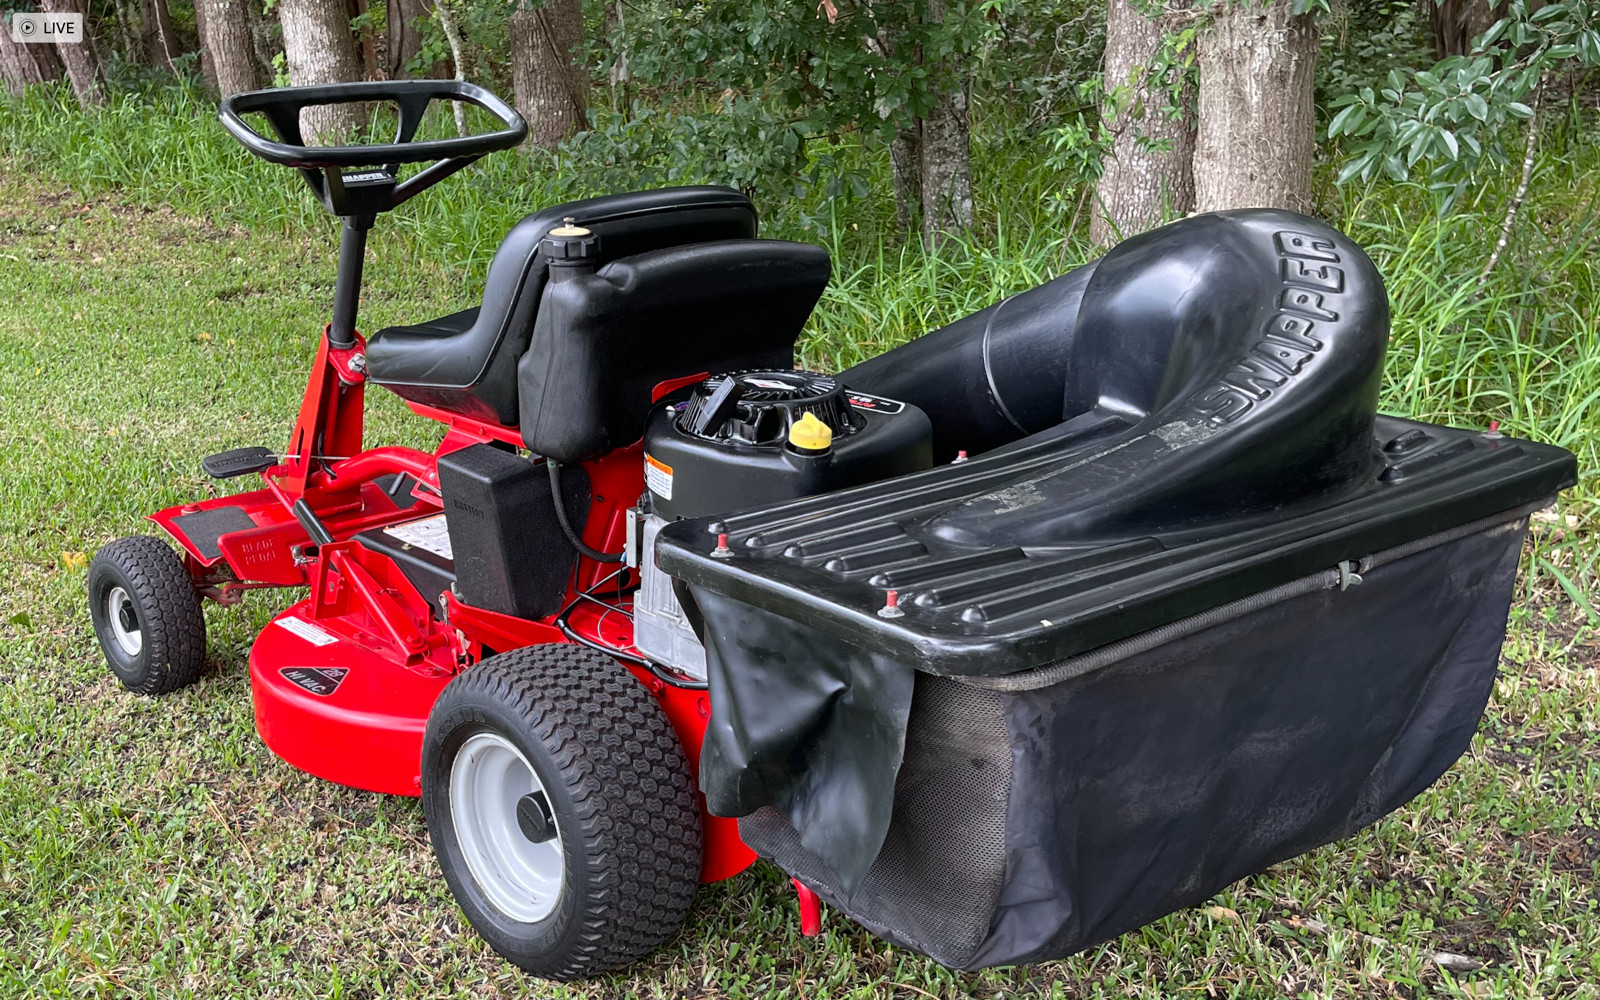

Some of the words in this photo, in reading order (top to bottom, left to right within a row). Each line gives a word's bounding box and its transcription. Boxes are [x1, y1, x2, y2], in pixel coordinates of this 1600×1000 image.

[1188, 230, 1345, 424] SNAPPER
[453, 499, 485, 520] BATTERY
[242, 538, 275, 553] BLADE
[245, 550, 278, 565] PEDAL
[285, 671, 306, 680] HI
[300, 678, 326, 692] VAC
